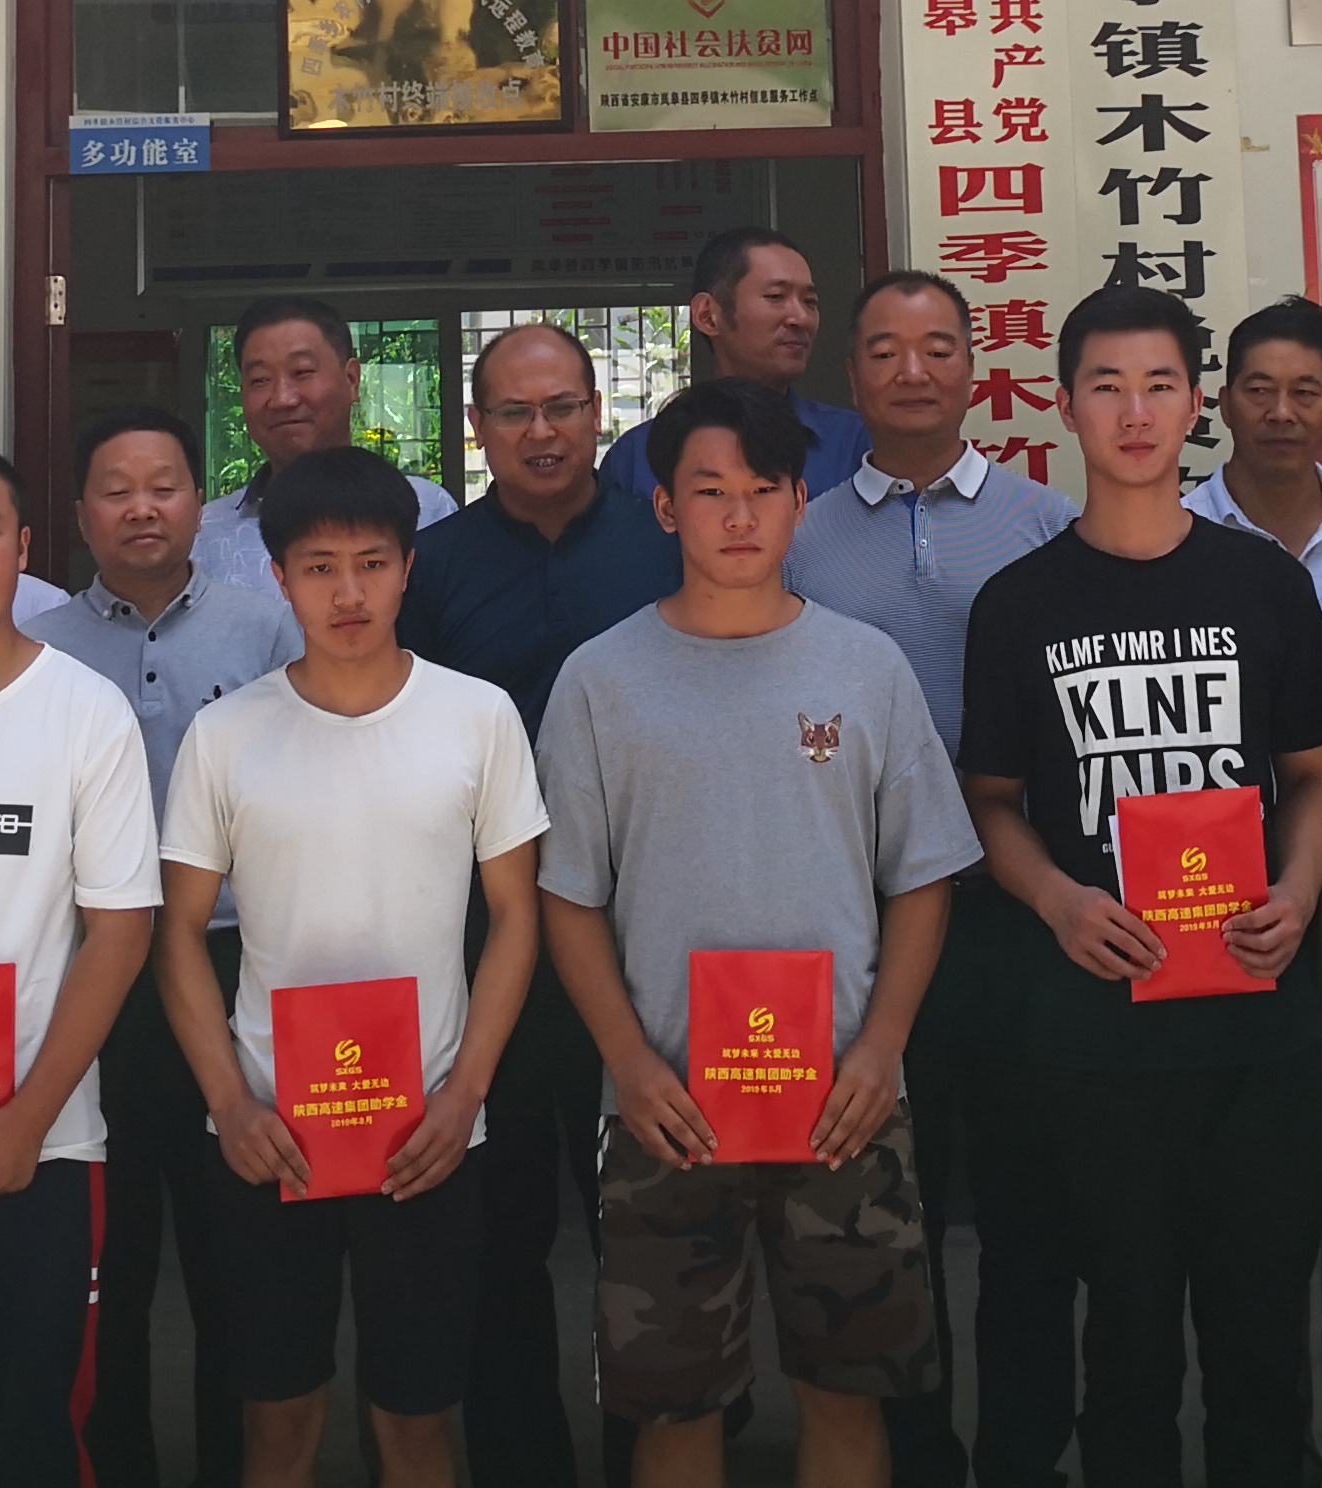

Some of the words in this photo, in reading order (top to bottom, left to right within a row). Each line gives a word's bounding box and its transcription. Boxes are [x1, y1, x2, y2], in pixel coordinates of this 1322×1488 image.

[603, 28, 814, 60] 中国社会扶贫网
[329, 78, 524, 114] 木竹村终端接收点
[81, 137, 199, 168] 多功能室
[1045, 634, 1106, 675] KLMF
[1111, 629, 1167, 662] VMR
[1190, 626, 1238, 657] NES
[1066, 671, 1228, 744] KLNF
[1181, 873, 1209, 883] SXGS
[1141, 899, 1252, 922] 陕西高速集团助学金
[704, 1066, 817, 1081] 陕西高速集团助学金
[293, 1094, 408, 1118] 陕西高速集团助学金
